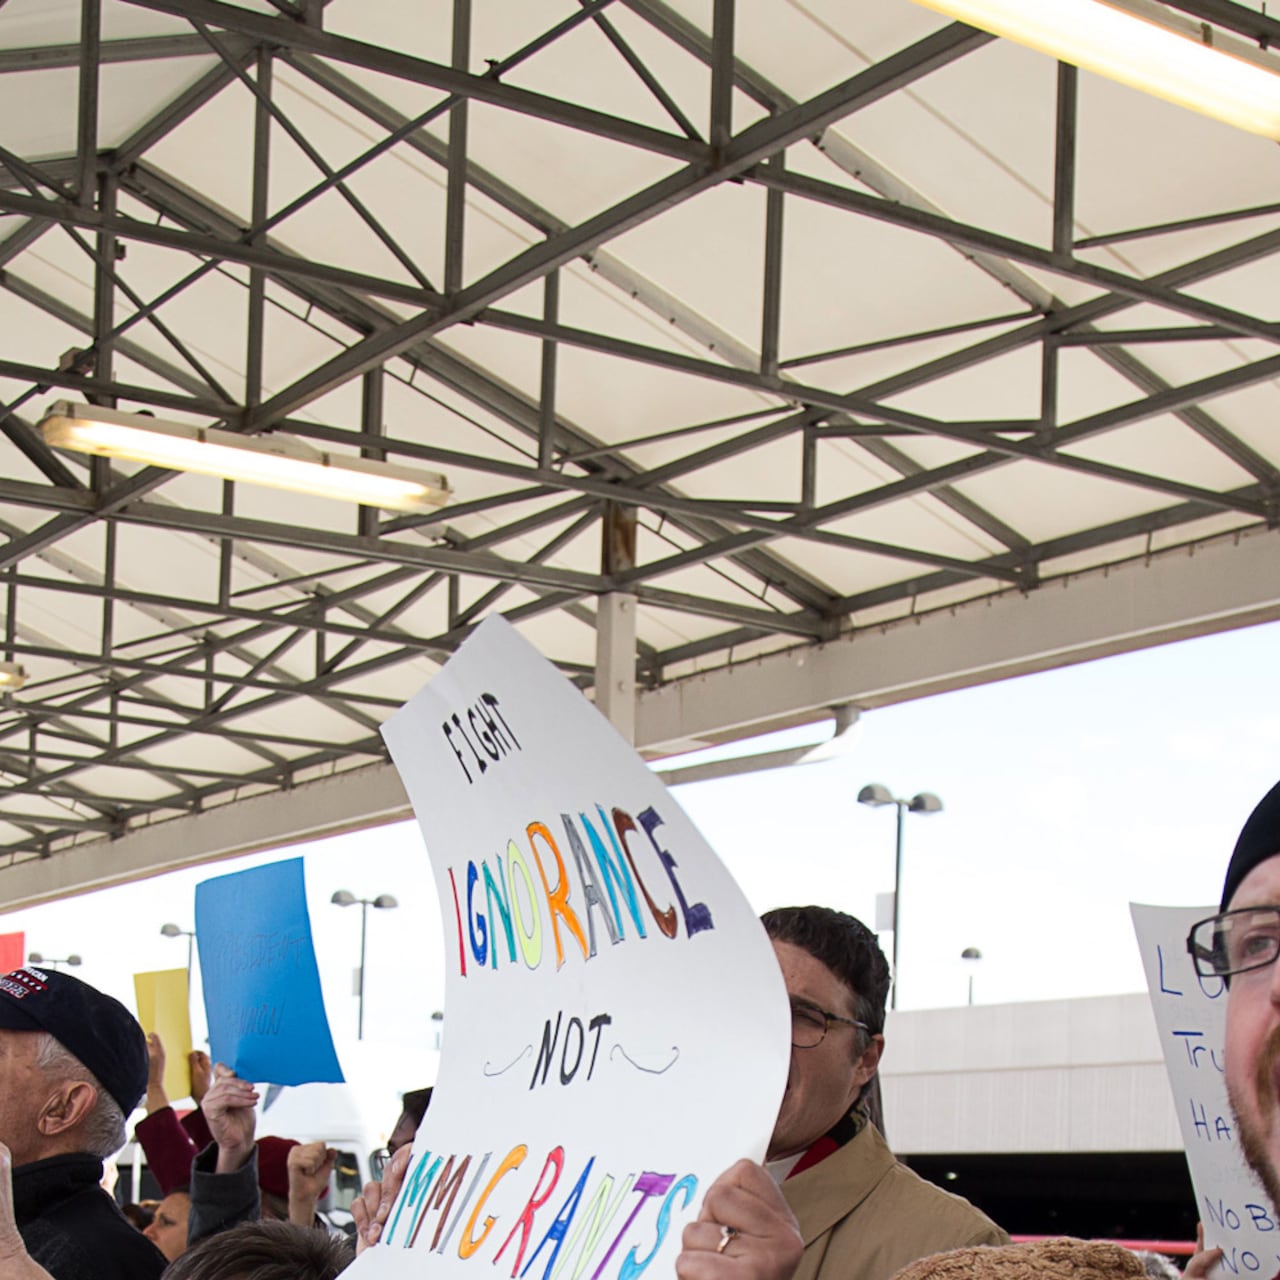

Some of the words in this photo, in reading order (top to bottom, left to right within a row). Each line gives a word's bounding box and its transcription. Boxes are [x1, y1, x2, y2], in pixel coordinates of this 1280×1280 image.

[441, 691, 523, 785] FIGHT
[447, 802, 716, 978] IGNORANCE
[528, 1010, 613, 1091] NOT
[1171, 1030, 1224, 1073] Tru
[1189, 1098, 1231, 1142] HA
